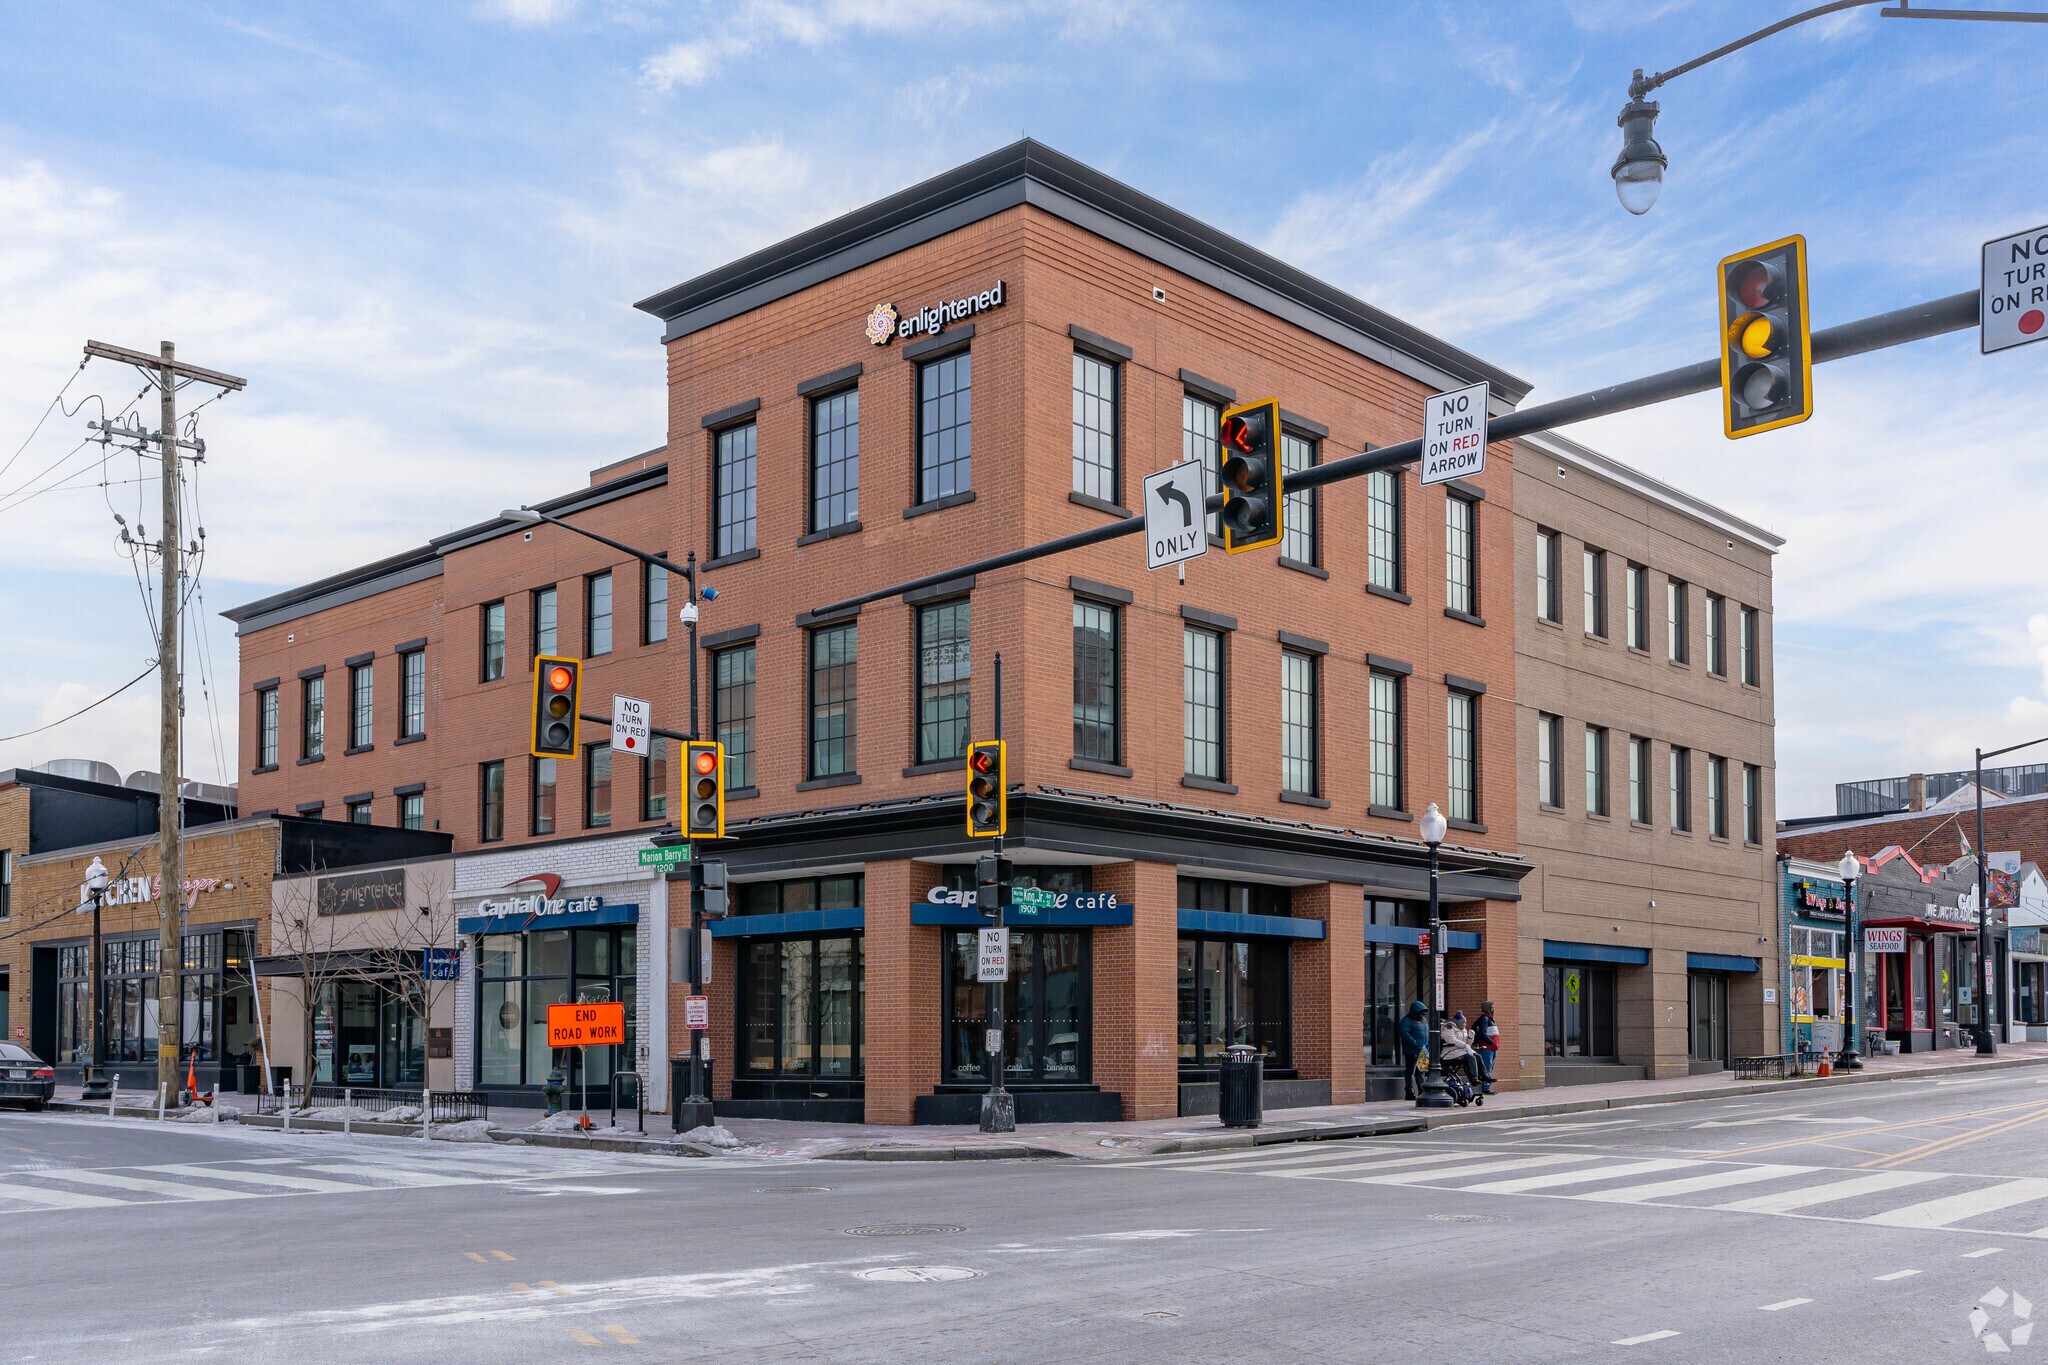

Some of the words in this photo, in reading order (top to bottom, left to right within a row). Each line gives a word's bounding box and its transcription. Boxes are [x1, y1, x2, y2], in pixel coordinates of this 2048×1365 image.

[2004, 263, 2046, 287] TUR
[899, 280, 1002, 336] enlightened
[1991, 292, 2019, 314] ON
[1443, 395, 1469, 417] NO
[1438, 415, 1473, 437] TURN
[1429, 441, 1448, 457] ON
[1453, 433, 1480, 452] RED
[1428, 451, 1478, 475] ARROW
[1155, 530, 1198, 558] ONLY
[624, 700, 640, 714] NO
[621, 713, 643, 726] TURN
[616, 723, 628, 734] ON
[630, 726, 647, 738] RED
[641, 851, 663, 863] Marion
[664, 849, 682, 862] Barry
[656, 863, 674, 873] 1200
[567, 896, 599, 913] café
[1075, 893, 1118, 909] café
[1020, 904, 1037, 914] 1900
[987, 932, 999, 942] NO
[1867, 930, 1902, 942] WINGS
[985, 945, 1002, 954] TURN
[1869, 942, 1899, 950] SEAFOOD
[982, 957, 990, 965] ON
[992, 957, 1005, 965] RED
[432, 967, 454, 977] café
[982, 967, 1005, 976] ARROW
[575, 1009, 597, 1022] END
[554, 1027, 582, 1040] ROAD
[589, 1026, 617, 1039] WORK
[750, 1060, 769, 1069] banking
[788, 1060, 805, 1069] coffee
[829, 1060, 841, 1069] café
[957, 1063, 981, 1072] coffee
[1007, 1063, 1023, 1072] café
[1046, 1063, 1076, 1073] banking
